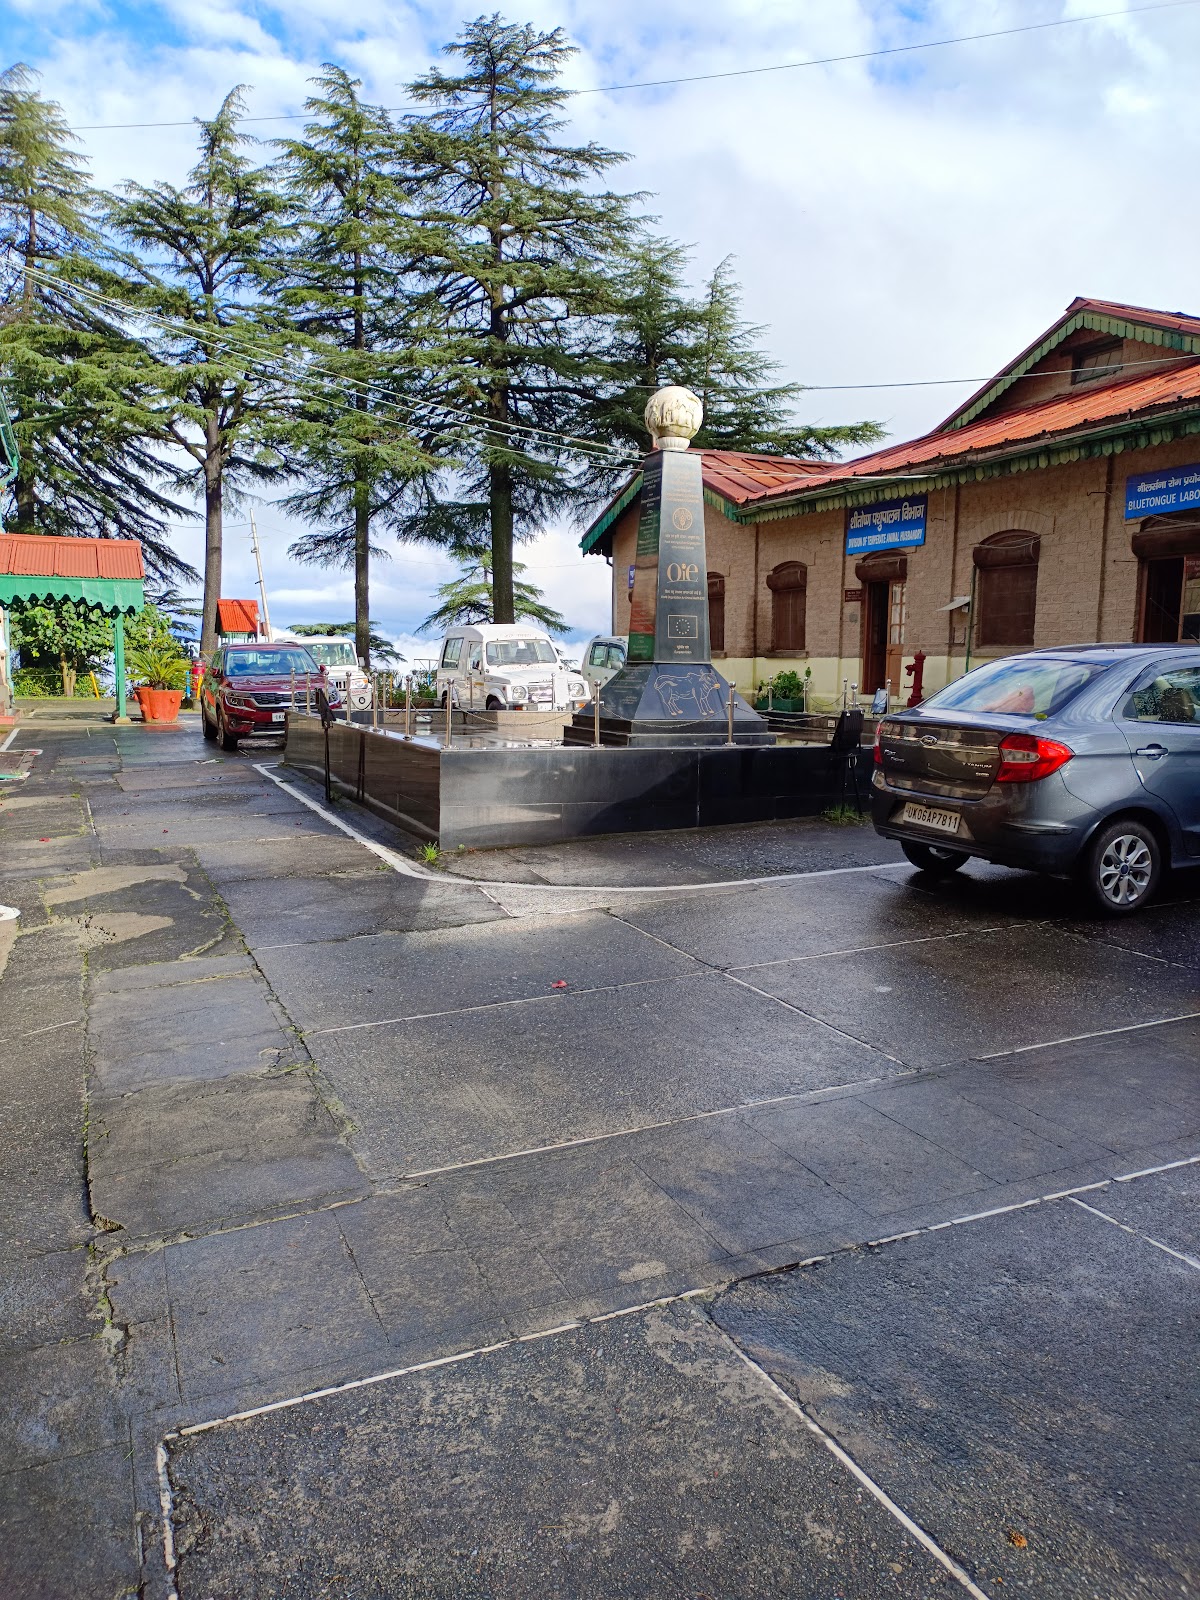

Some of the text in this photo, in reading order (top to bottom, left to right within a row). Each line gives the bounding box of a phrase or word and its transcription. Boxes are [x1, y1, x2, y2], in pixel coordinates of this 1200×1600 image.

[1168, 477, 1182, 487] रोग
[1128, 493, 1176, 511] BLUETONGUE
[872, 509, 901, 532] पशुपालन
[902, 502, 925, 521] विभाग
[848, 538, 862, 548] DIVISION
[900, 528, 923, 542] HUSBANDRY
[907, 806, 958, 829] UK06AP7811
